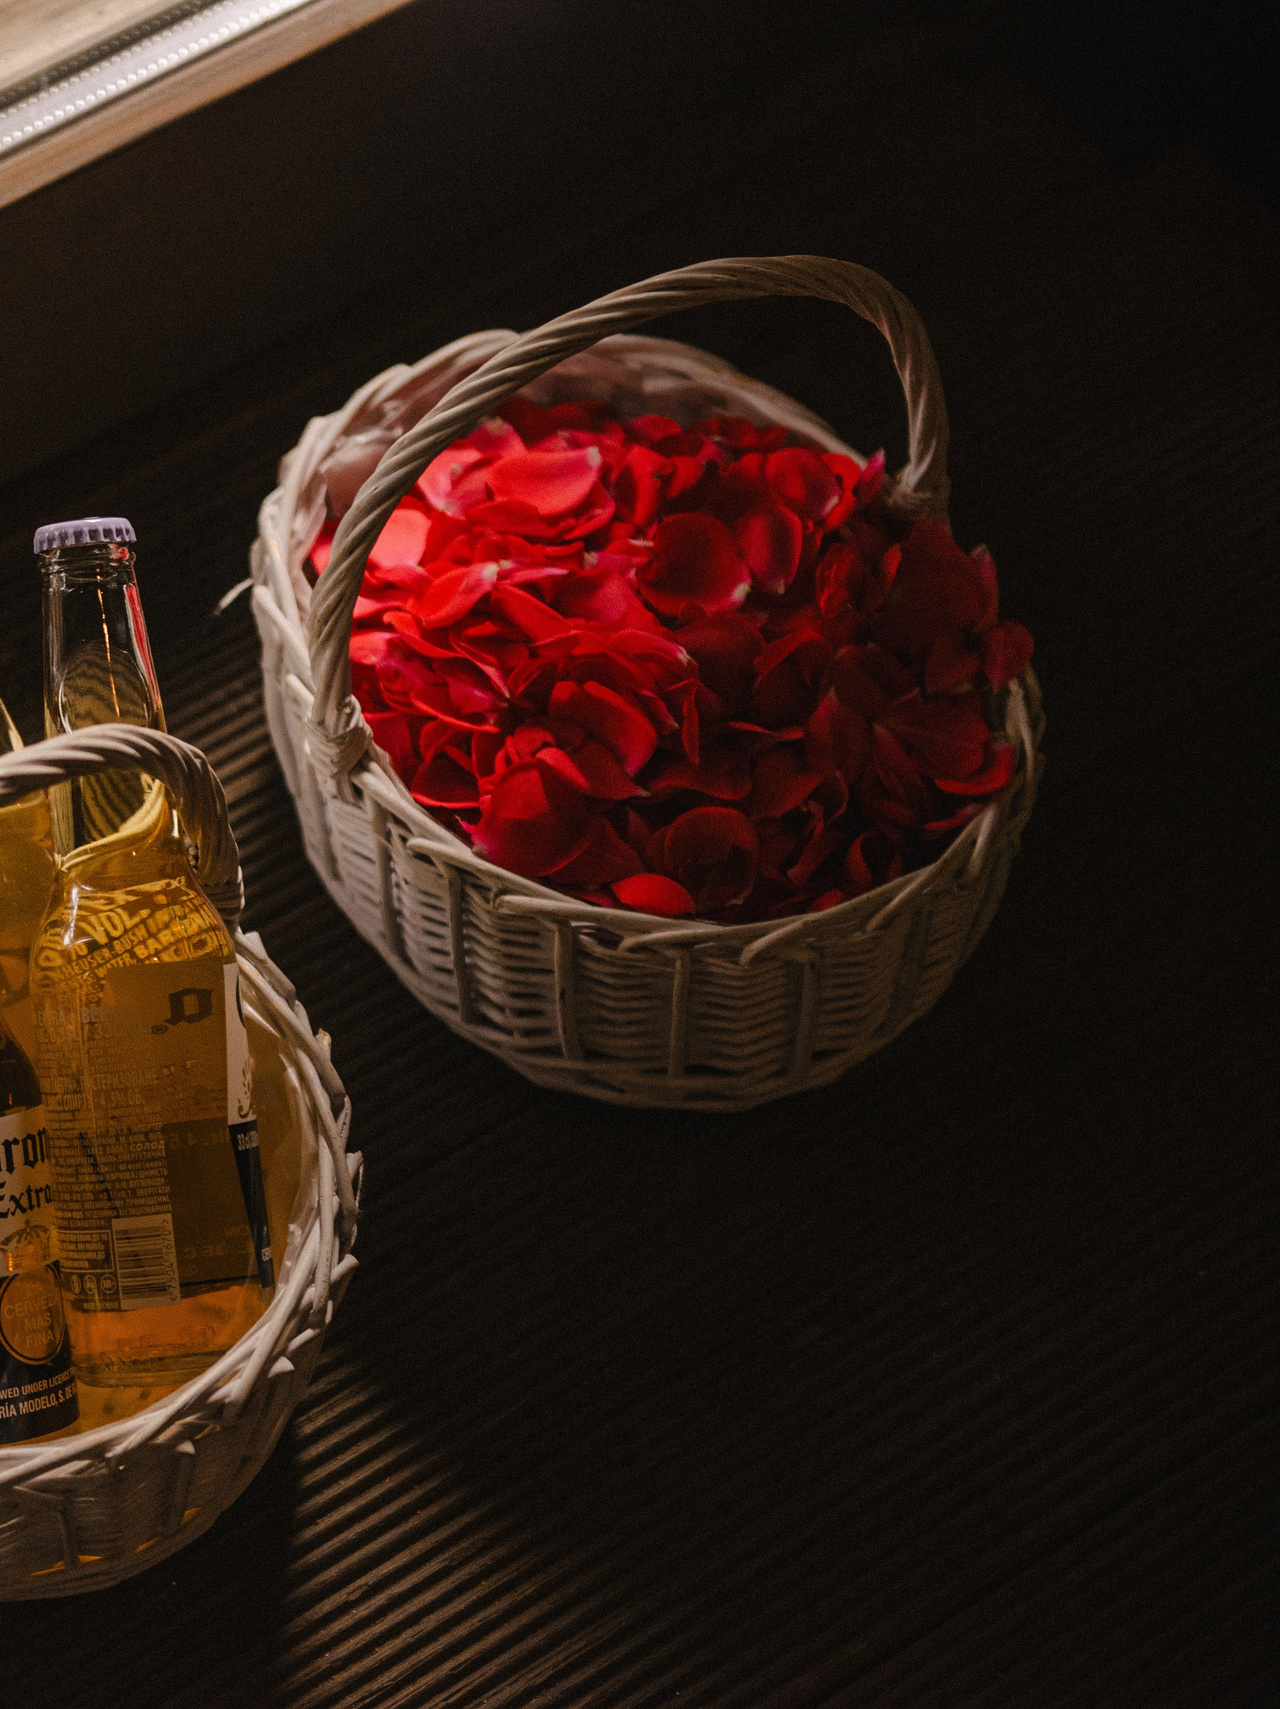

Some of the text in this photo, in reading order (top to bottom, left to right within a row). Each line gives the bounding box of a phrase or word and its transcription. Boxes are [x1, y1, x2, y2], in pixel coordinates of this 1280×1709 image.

[130, 1140, 165, 1152] СОЛОД
[24, 1312, 51, 1332] MAS
[26, 1329, 54, 1349] FINA
[21, 1380, 48, 1396] UNDER
[19, 1393, 58, 1415] MODELO,
